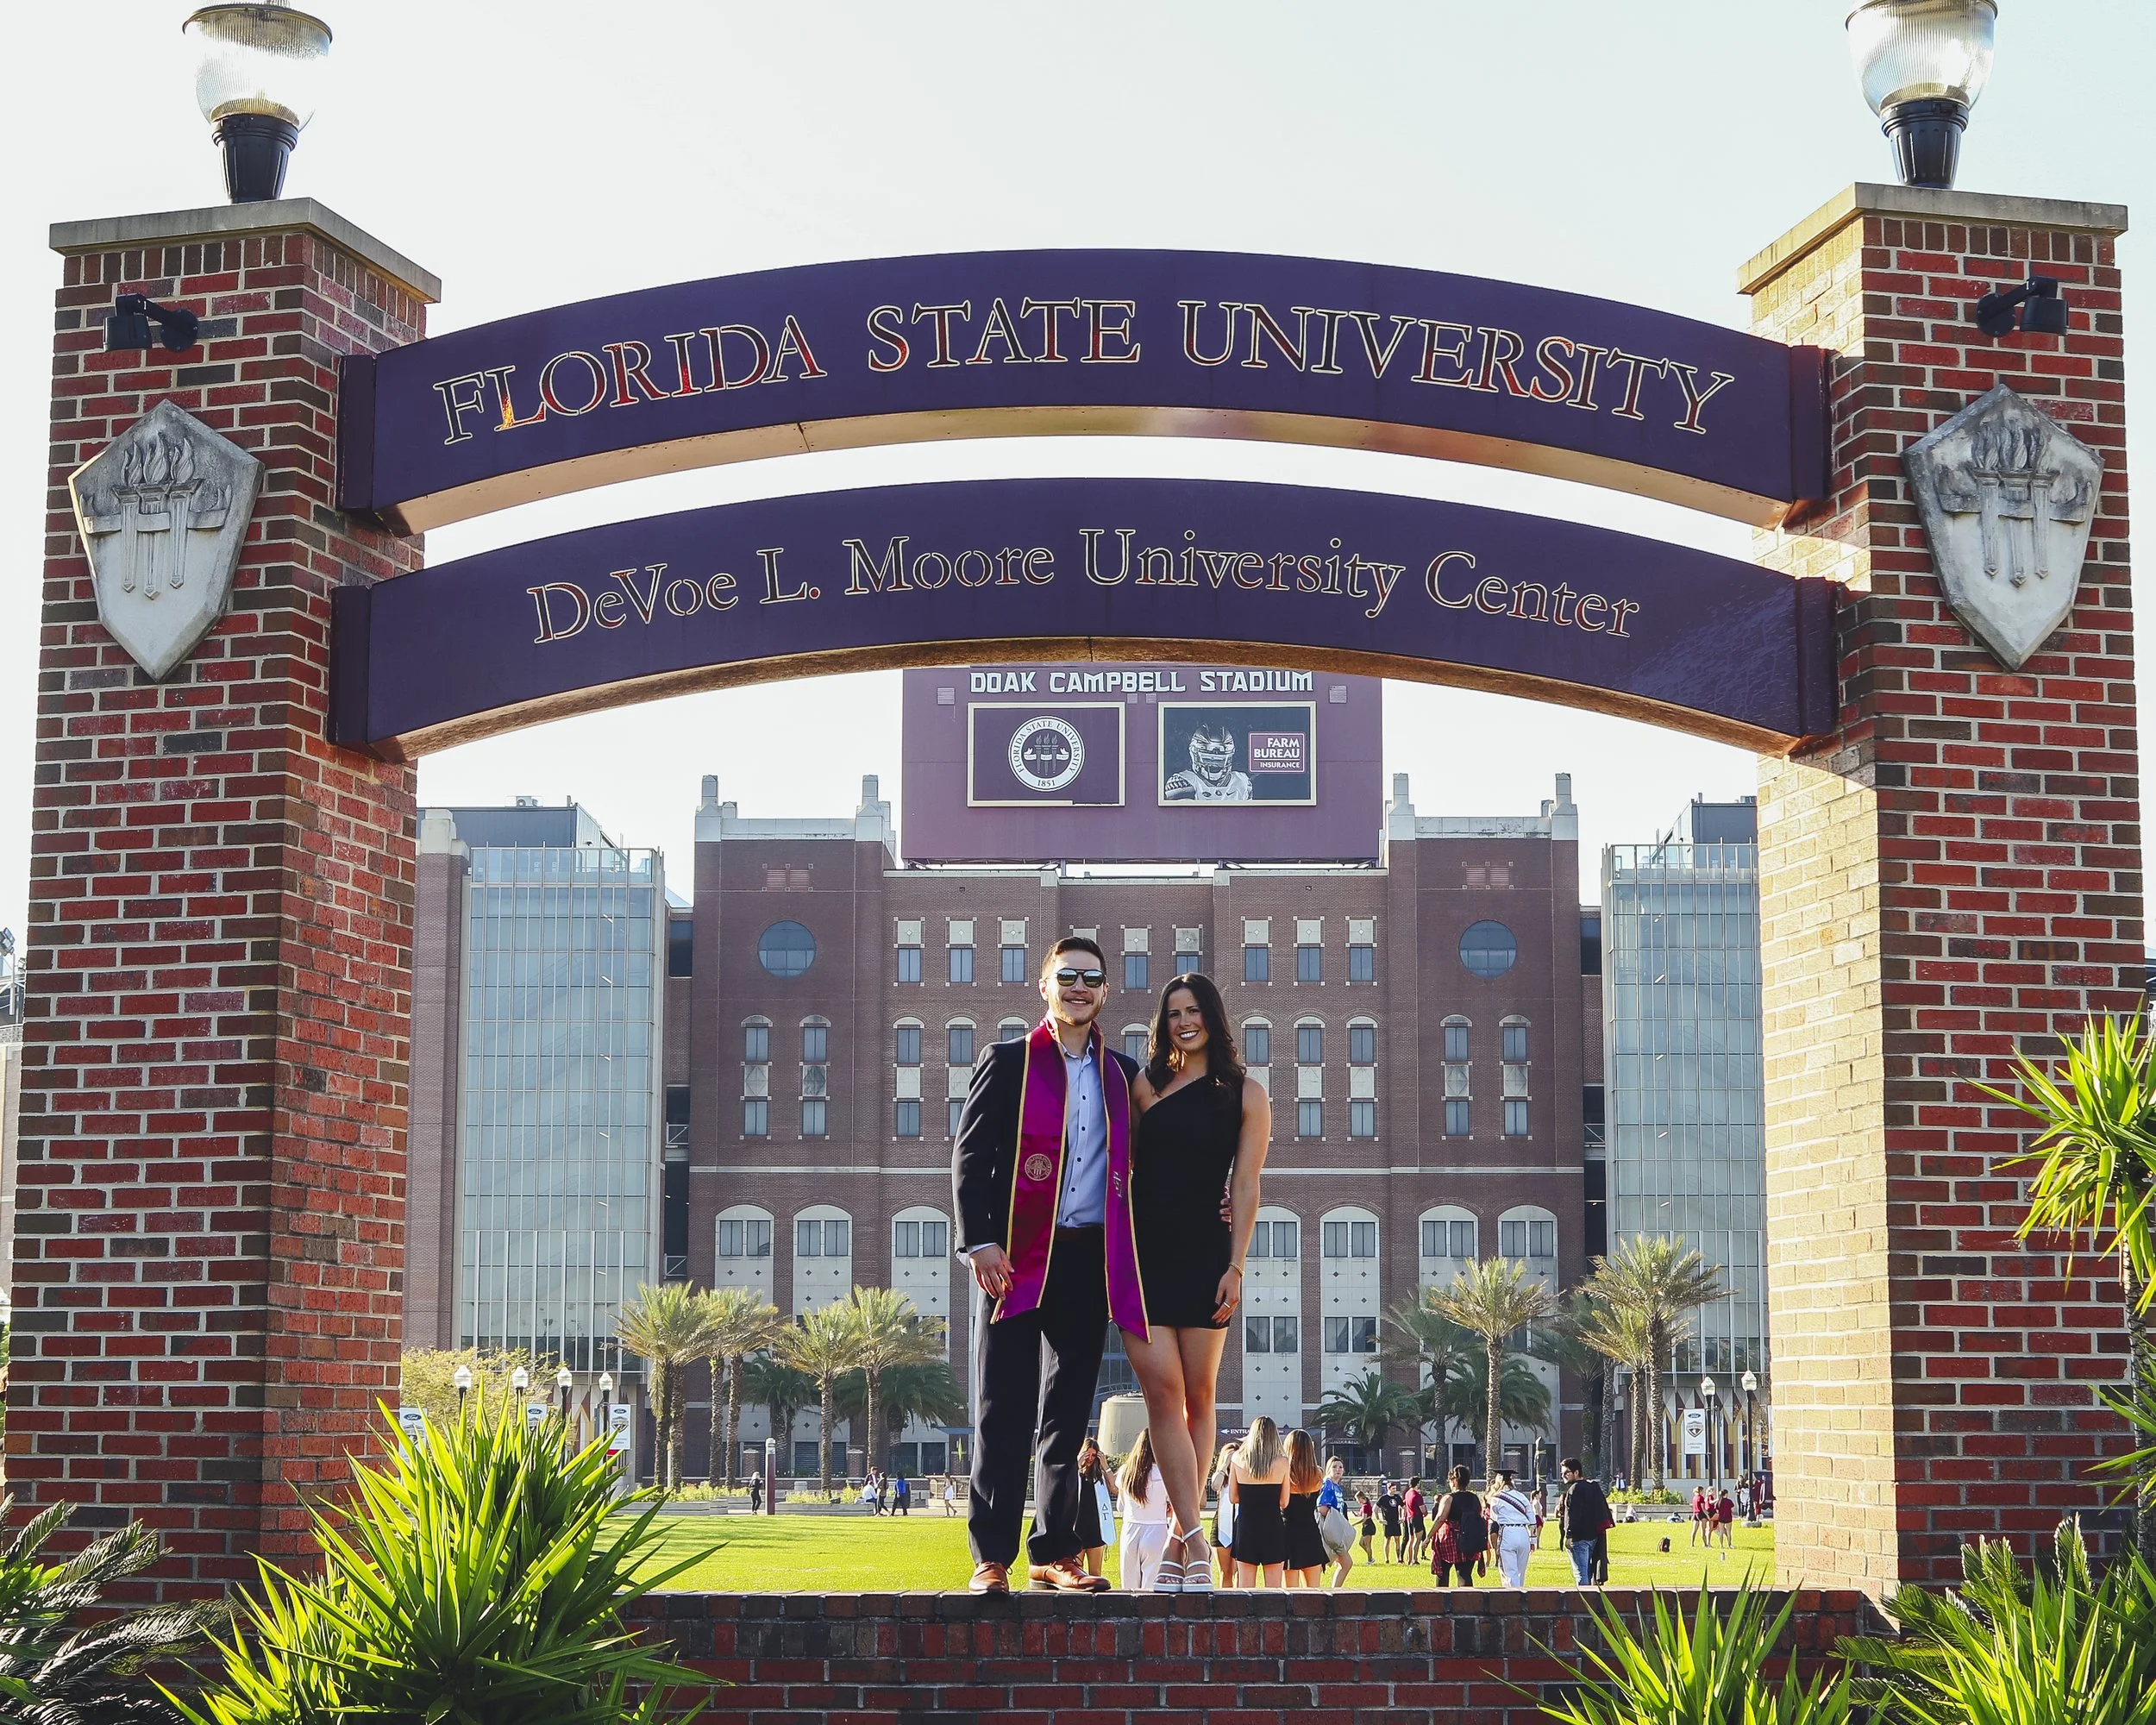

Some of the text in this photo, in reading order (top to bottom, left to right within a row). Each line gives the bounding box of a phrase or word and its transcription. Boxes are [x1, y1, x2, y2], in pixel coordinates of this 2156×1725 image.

[433, 297, 1734, 445] FLORIDA STATE UNIVERSITY
[527, 529, 1640, 644] DeVoe L. Moore University Center
[970, 670, 1313, 693] DOAK CAMPBELL STADIUM
[1013, 720, 1080, 774] FLORIDA STATE UNIVERSITY
[1254, 748, 1300, 758] BUREAU
[1267, 737, 1300, 748] FARM
